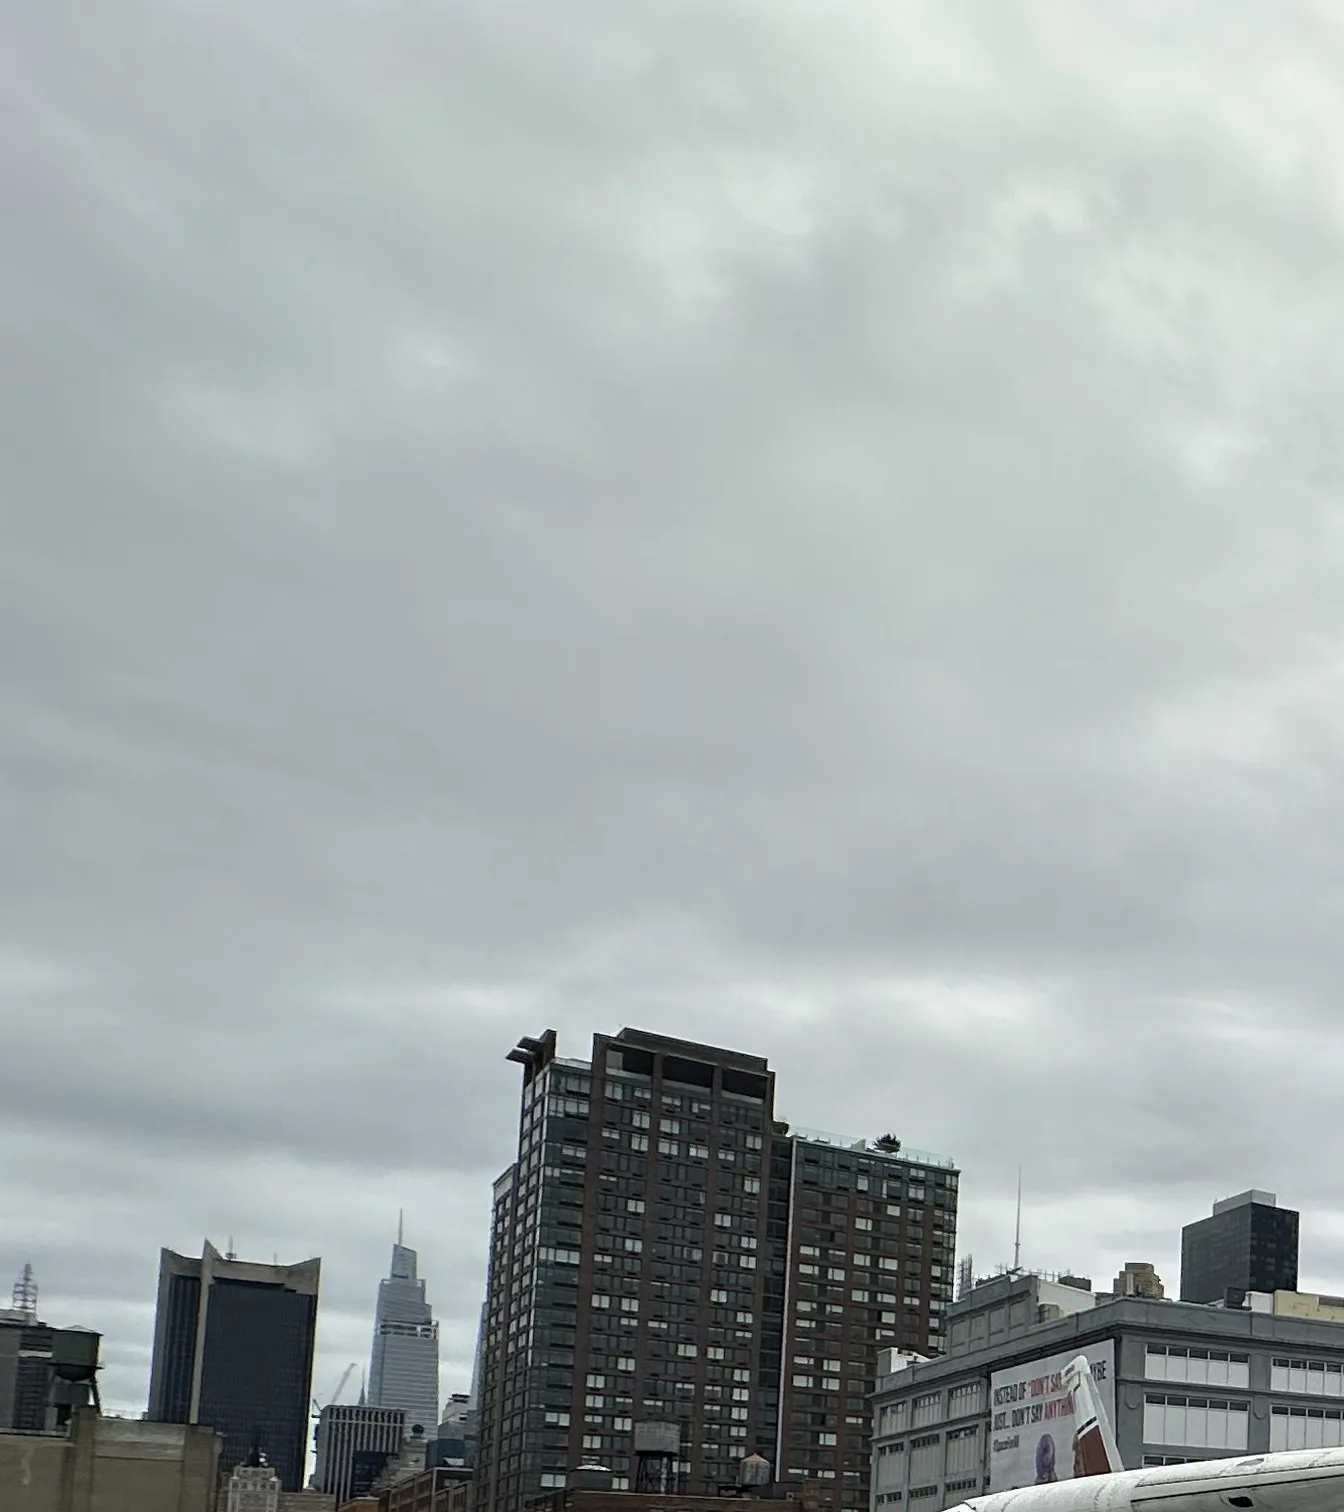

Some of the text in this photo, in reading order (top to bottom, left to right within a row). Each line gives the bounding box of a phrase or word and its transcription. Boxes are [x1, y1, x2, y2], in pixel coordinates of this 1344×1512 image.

[994, 1383, 1018, 1405] INSTEAD
[1019, 1381, 1027, 1400] OF
[1011, 1405, 1031, 1428] DON'T
[1031, 1402, 1043, 1424] SAY
